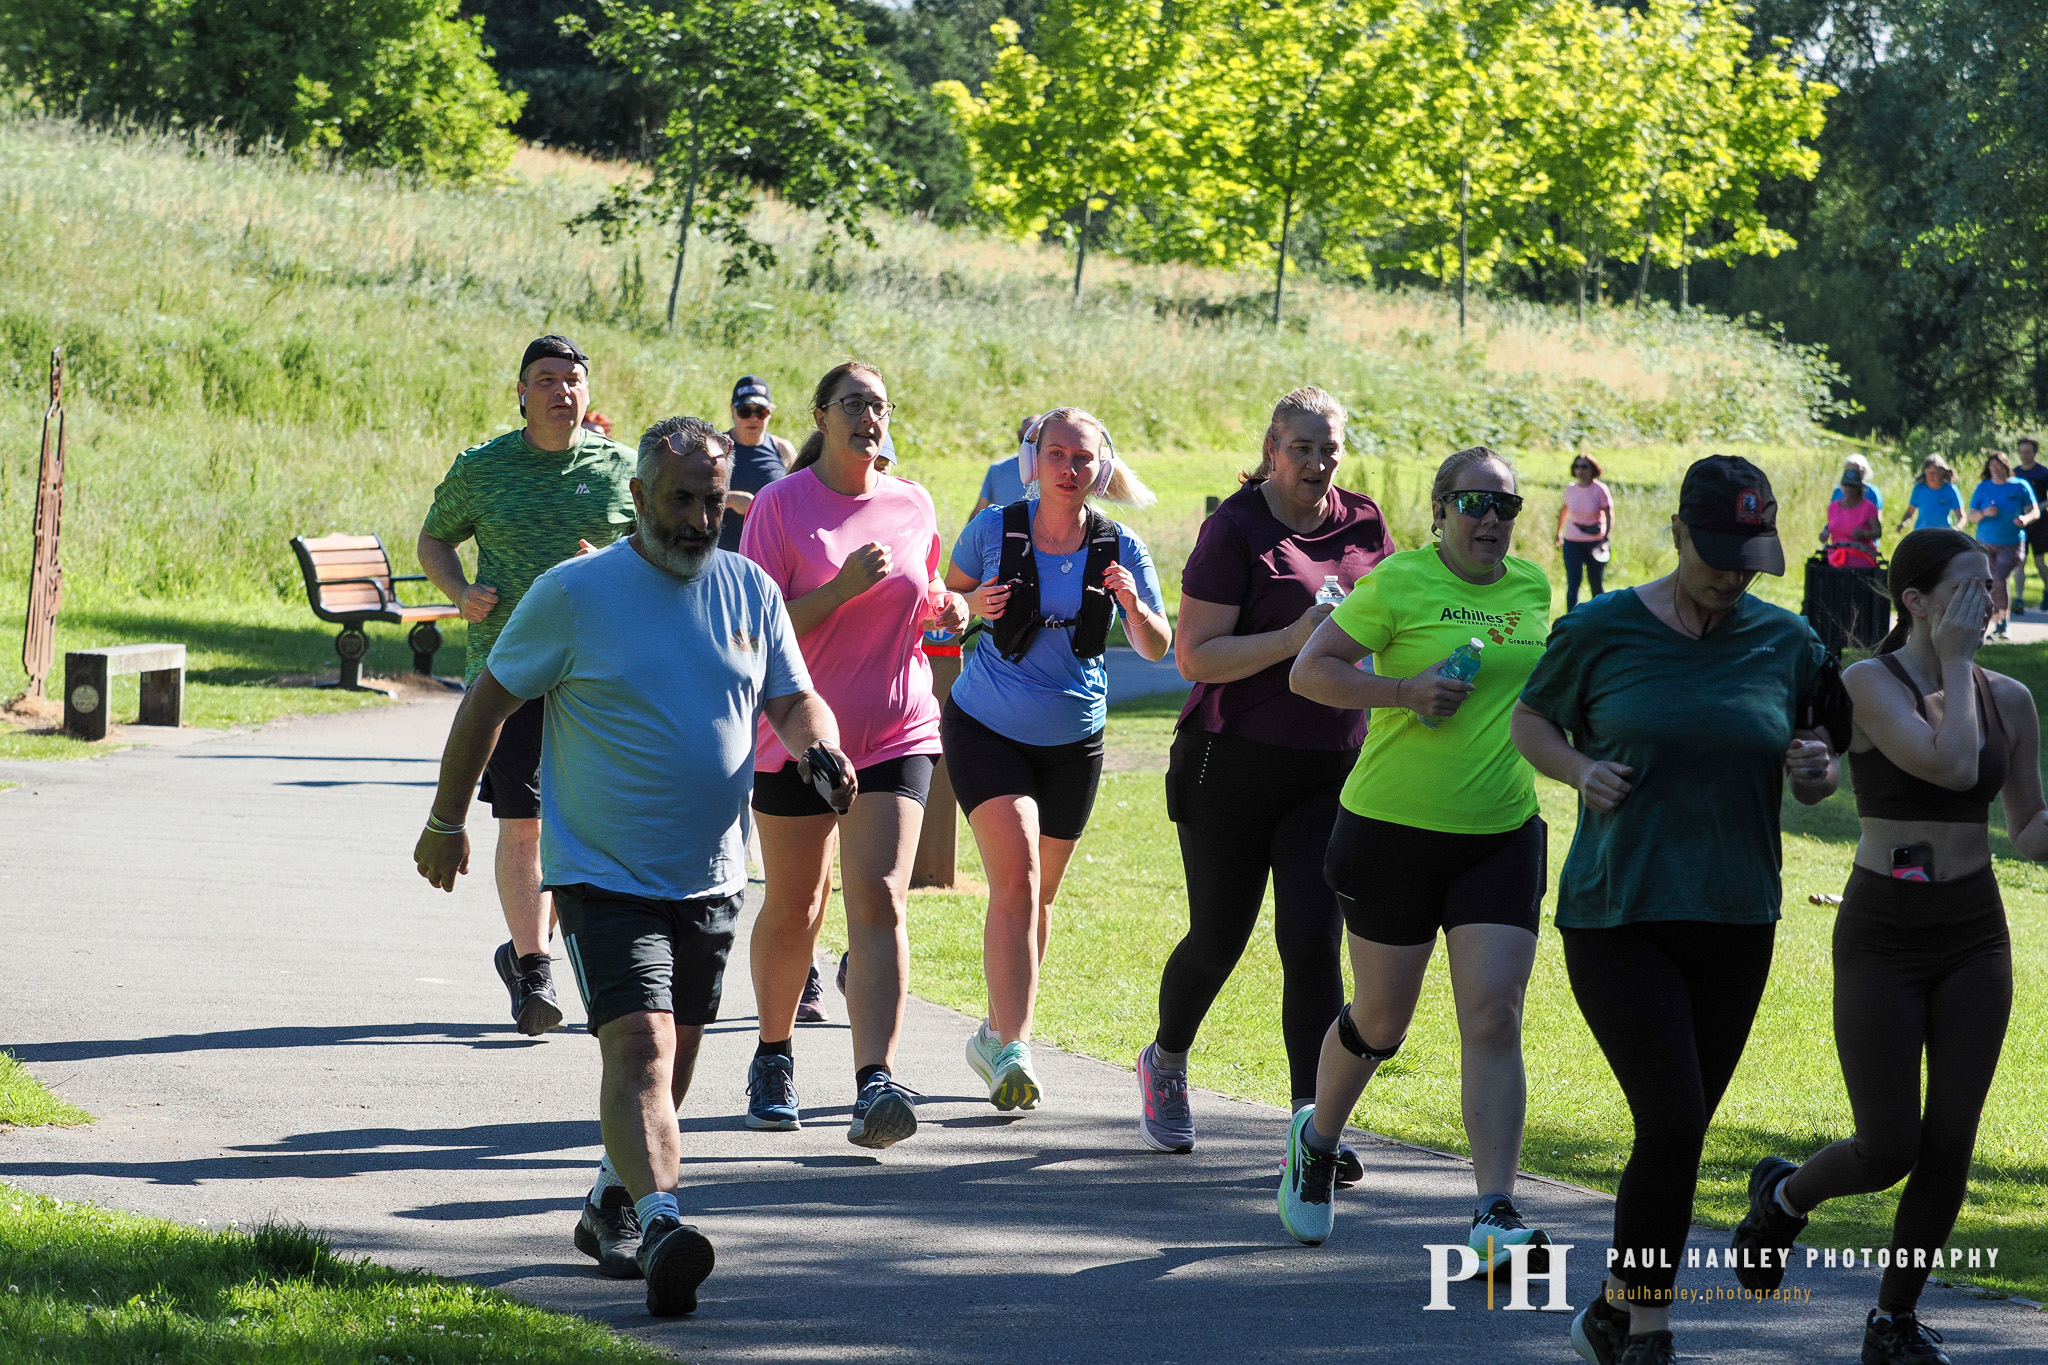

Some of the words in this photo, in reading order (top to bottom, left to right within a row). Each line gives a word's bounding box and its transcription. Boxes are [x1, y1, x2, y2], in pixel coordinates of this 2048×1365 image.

[1440, 607, 1504, 624] Achilles
[1456, 620, 1505, 628] INTERNATIONAL
[1508, 638, 1535, 646] Greater
